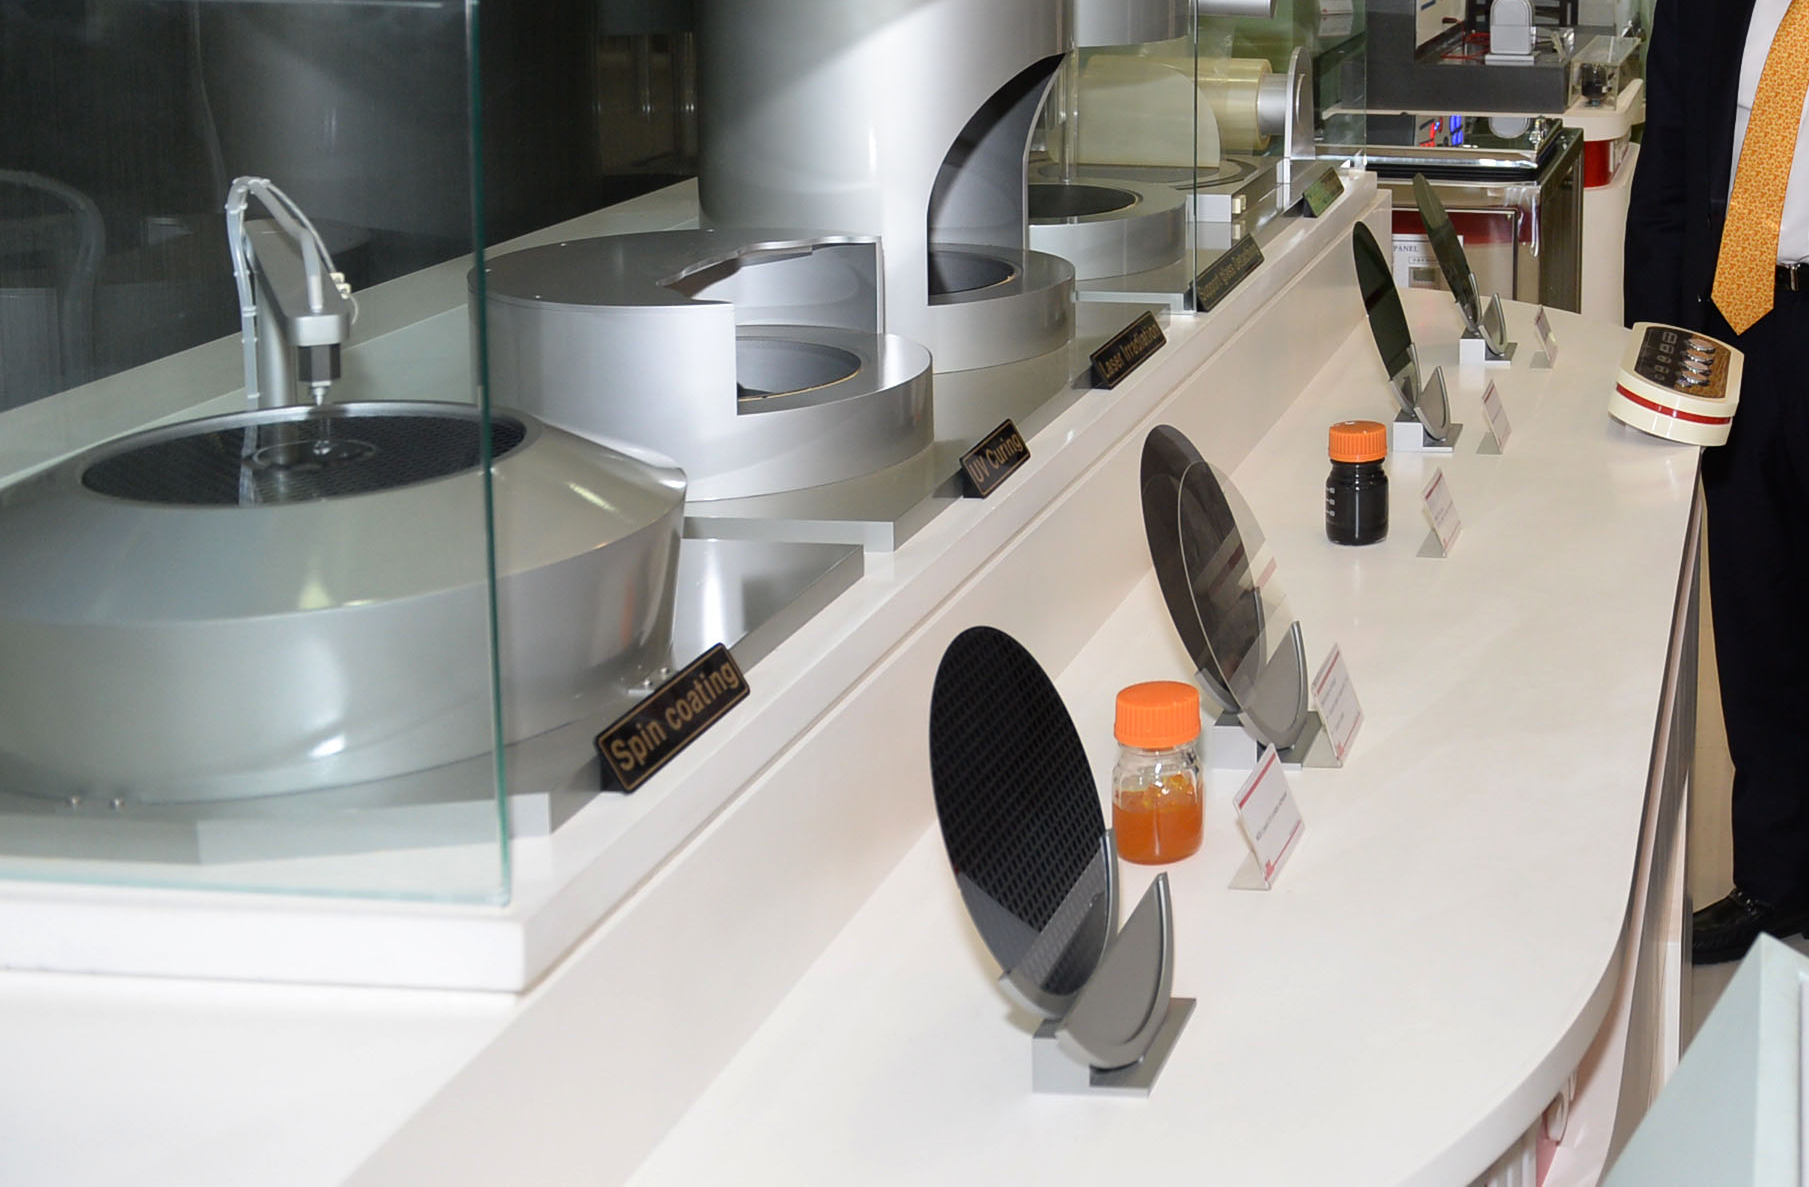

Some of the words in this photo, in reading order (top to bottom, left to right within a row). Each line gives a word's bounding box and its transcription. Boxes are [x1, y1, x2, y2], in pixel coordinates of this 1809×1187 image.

[1098, 352, 1125, 378] Laser
[1120, 324, 1160, 362] Irradiation
[969, 455, 990, 483] UV
[985, 434, 1023, 470] Curing
[610, 722, 667, 772] Spin
[665, 662, 740, 731] coating
